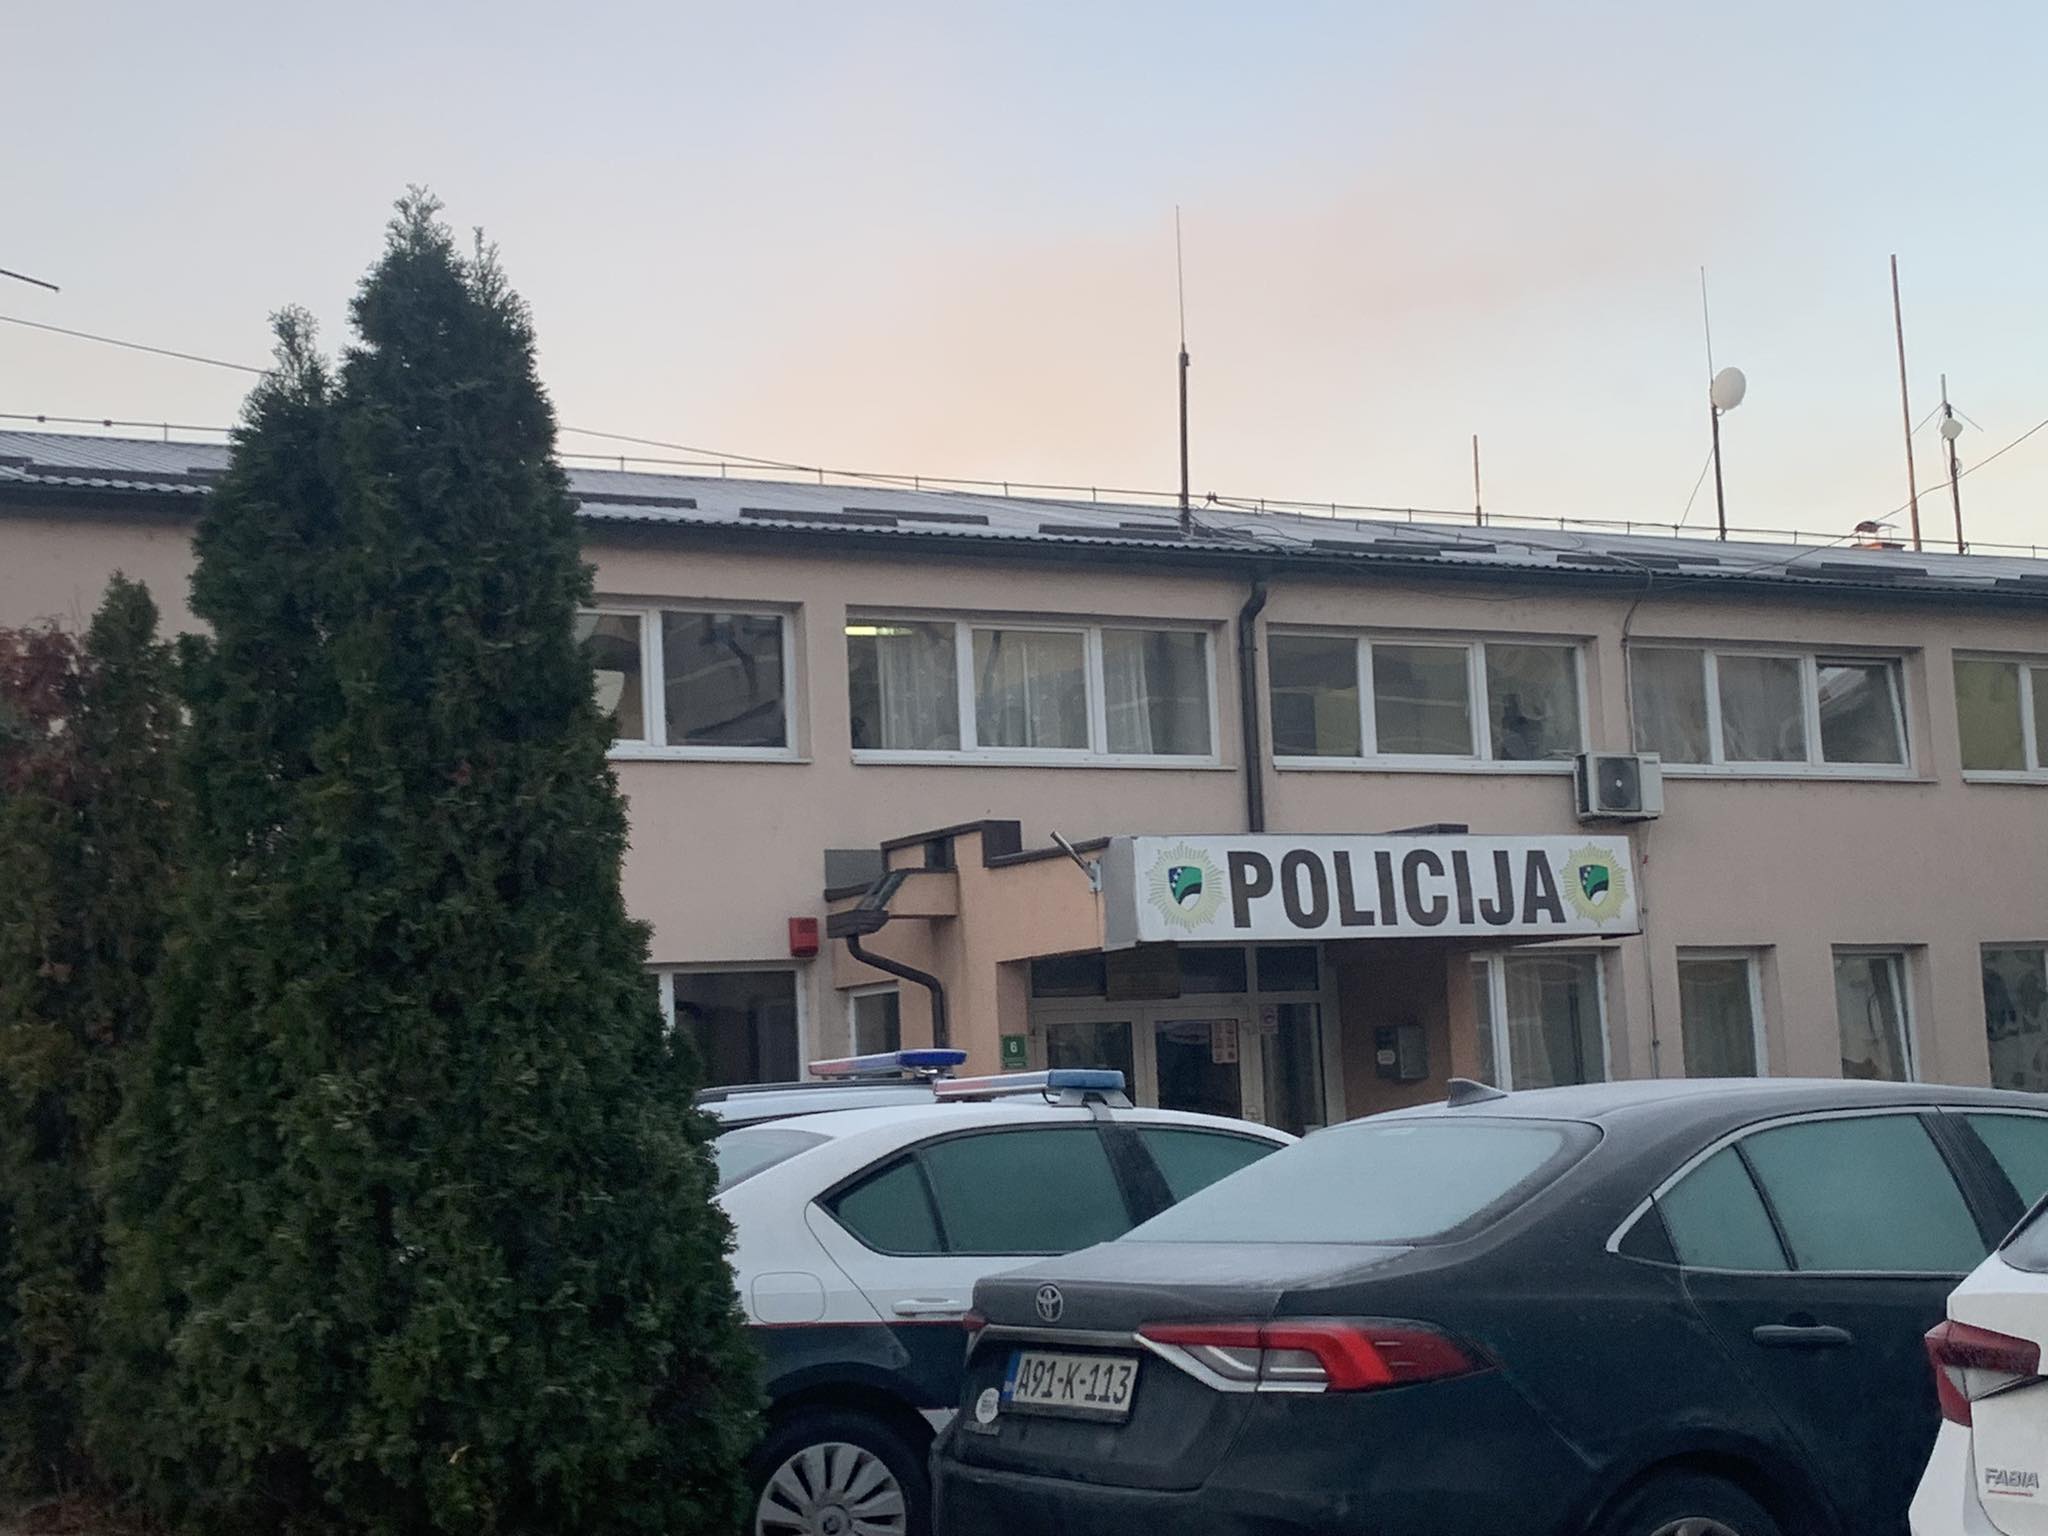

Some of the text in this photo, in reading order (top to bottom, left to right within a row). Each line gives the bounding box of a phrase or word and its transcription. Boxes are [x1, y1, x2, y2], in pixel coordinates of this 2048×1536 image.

[1226, 849, 1567, 929] POLICIJA
[1010, 1041, 1019, 1054] 6
[1016, 1358, 1132, 1404] A91-K-113
[1984, 1467, 2040, 1489] FABIA
